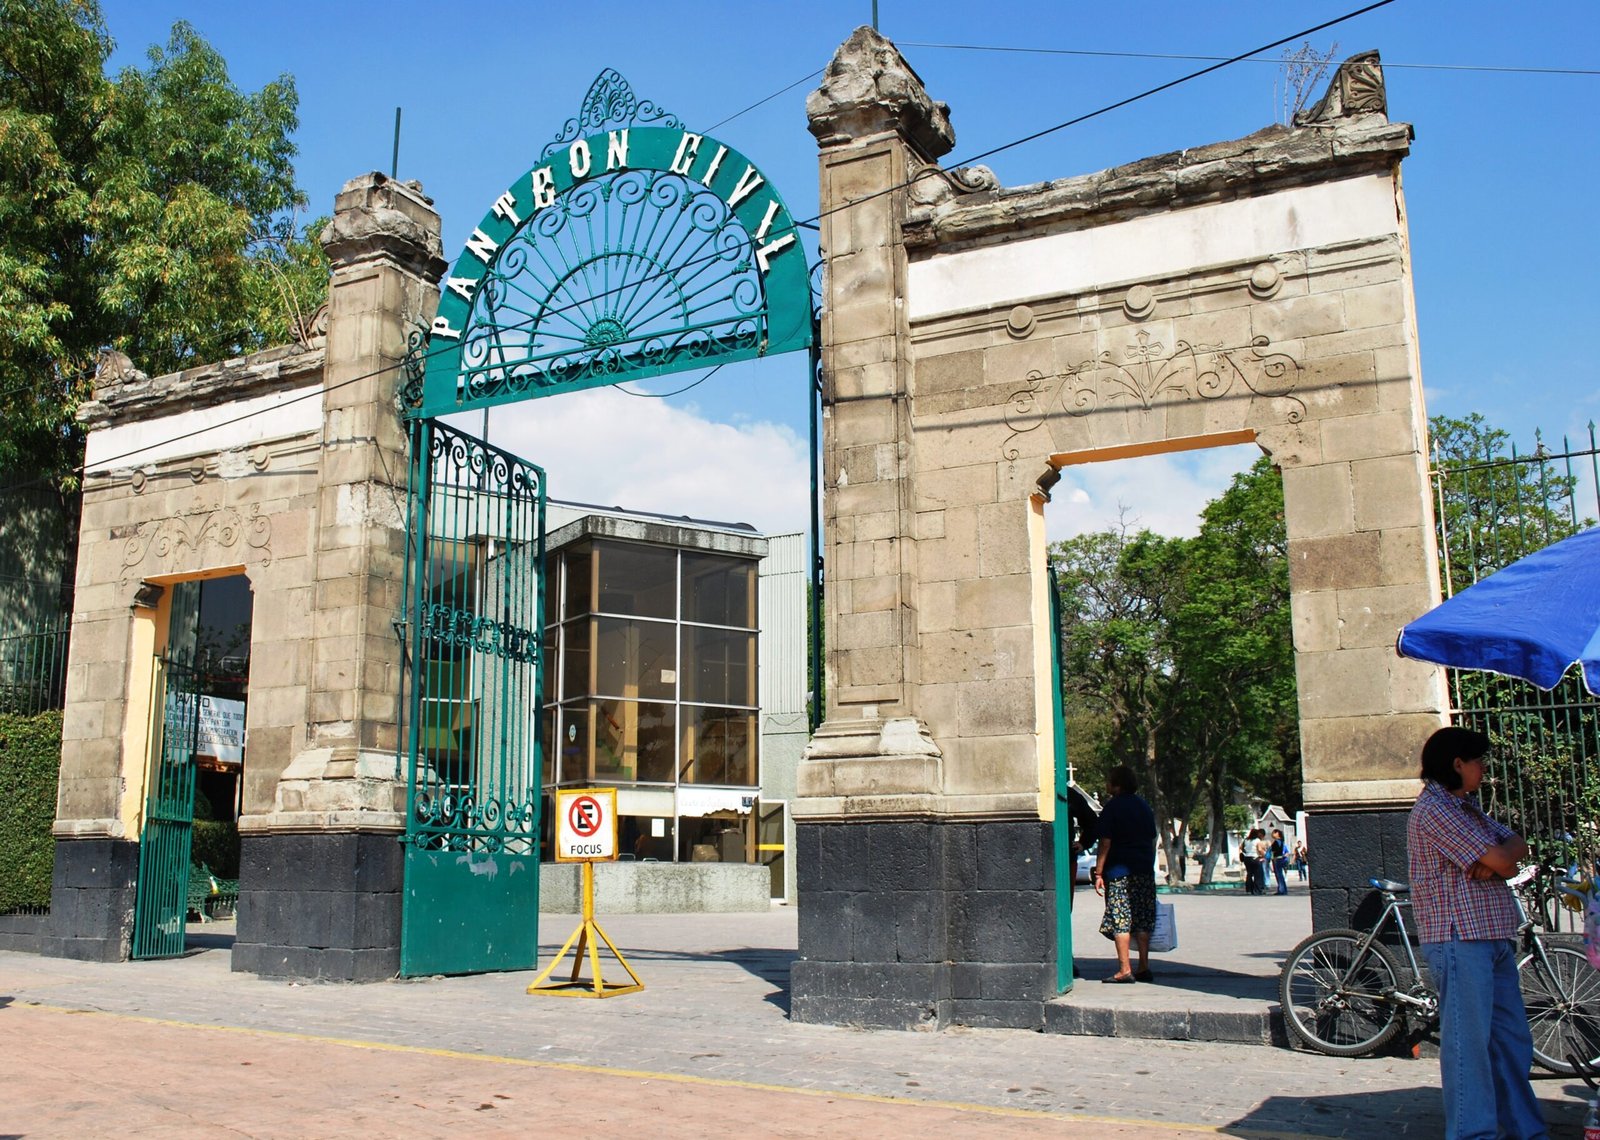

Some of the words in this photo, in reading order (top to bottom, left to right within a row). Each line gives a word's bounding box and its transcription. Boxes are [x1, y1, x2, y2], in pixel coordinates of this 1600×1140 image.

[431, 128, 629, 339] PANTEON
[670, 132, 797, 273] CIVIL
[577, 804, 593, 829] E
[570, 844, 602, 855] FOCUS
